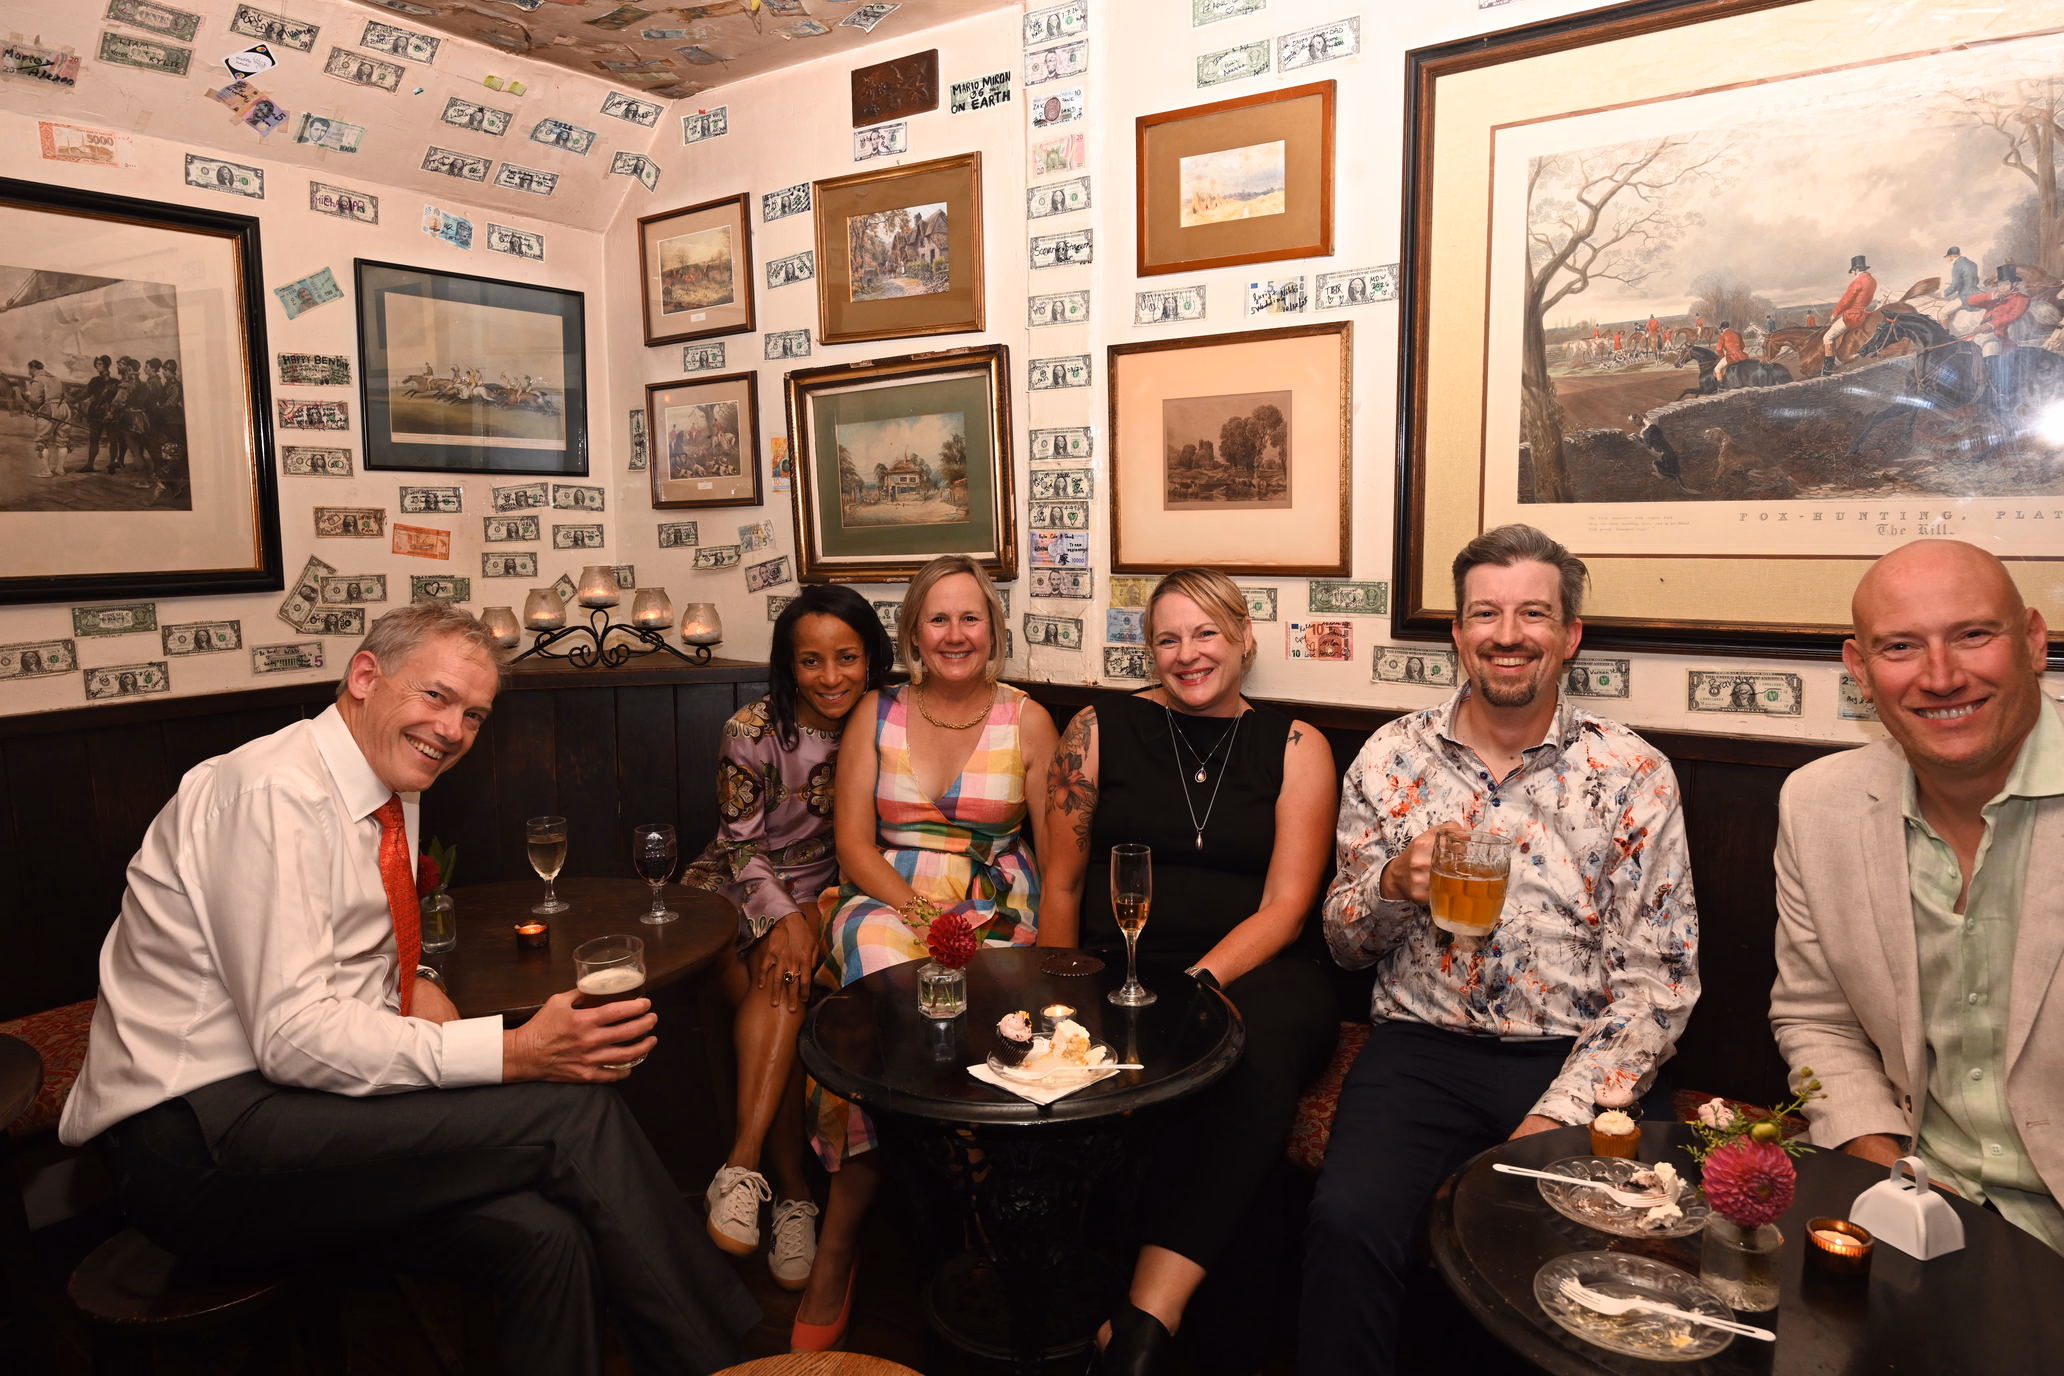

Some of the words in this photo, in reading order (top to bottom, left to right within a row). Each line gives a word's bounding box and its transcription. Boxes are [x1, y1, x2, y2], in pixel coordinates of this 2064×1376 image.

[951, 80, 980, 97] MARIO
[982, 71, 1012, 87] MIRON
[969, 88, 985, 100] 36
[951, 102, 966, 114] ON
[971, 90, 1012, 111] EARTH
[86, 133, 114, 147] 5000
[282, 355, 311, 365] HAPPY
[1876, 524, 1907, 538] The
[1311, 623, 1324, 636] 10
[1292, 649, 1301, 658] 10
[314, 655, 324, 668] 5
